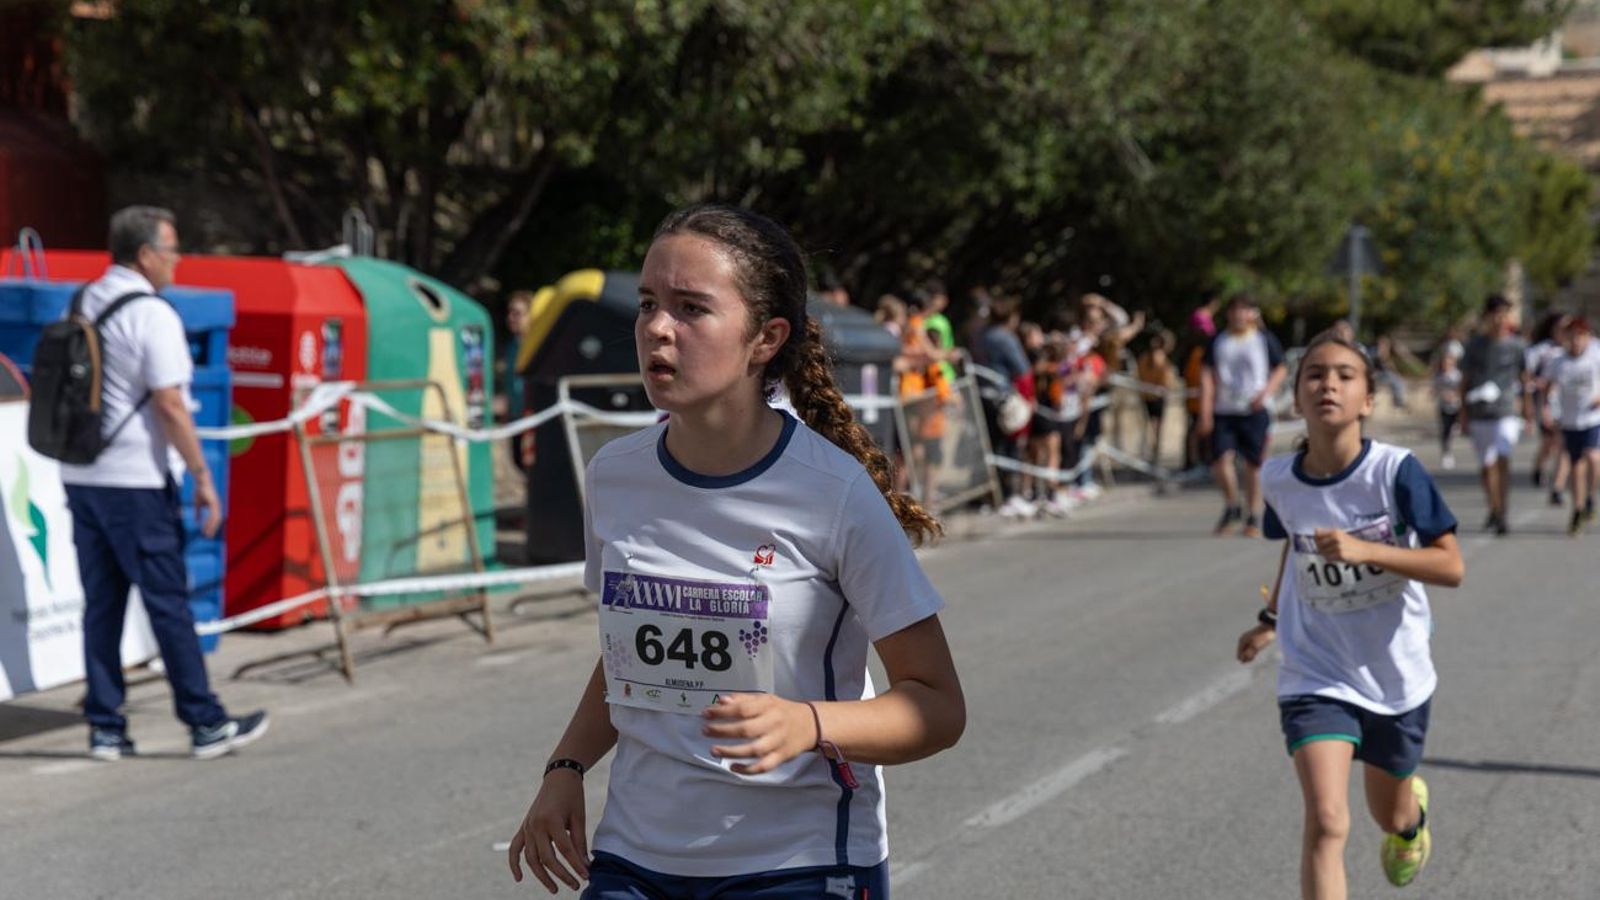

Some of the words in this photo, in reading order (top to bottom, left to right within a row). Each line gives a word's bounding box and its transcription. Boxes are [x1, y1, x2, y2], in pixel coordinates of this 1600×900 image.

[630, 580, 682, 609] XXXVI
[683, 586, 720, 600] CARRERA
[722, 589, 762, 602] ESCOLAR
[689, 599, 702, 612] LA
[710, 601, 750, 615] GLORIA
[635, 624, 733, 672] 648
